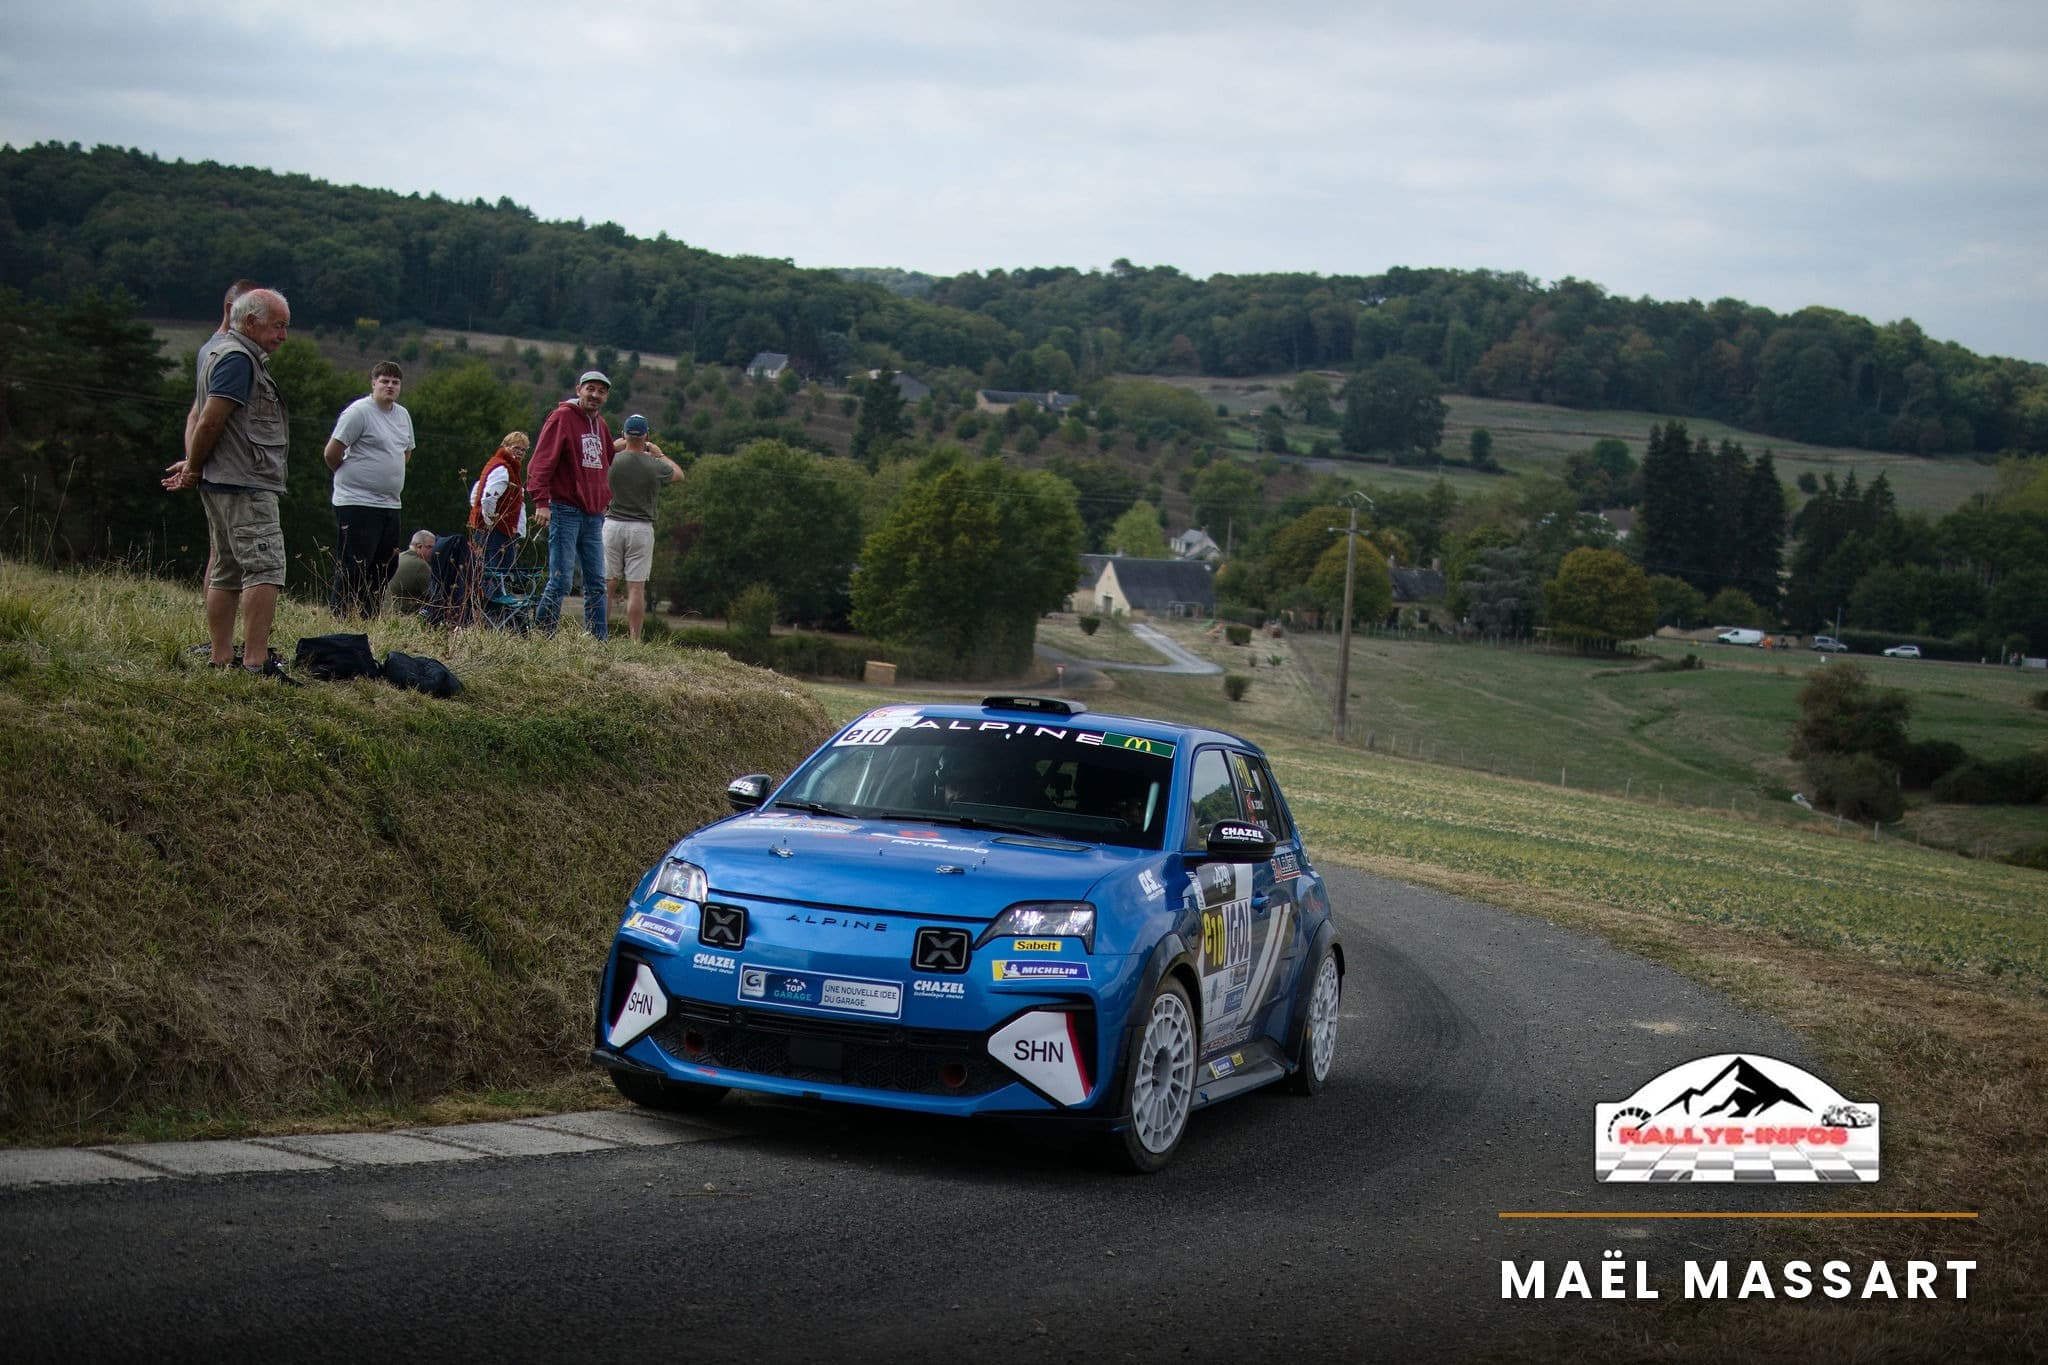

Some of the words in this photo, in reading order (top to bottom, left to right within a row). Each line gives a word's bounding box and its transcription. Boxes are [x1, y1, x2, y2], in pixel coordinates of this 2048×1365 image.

[842, 729, 893, 743] e10
[910, 720, 1102, 746] ALPINE
[1221, 827, 1264, 839] CHAZEL
[785, 914, 888, 932] ALPINE
[1016, 940, 1057, 951] Sabelt
[1203, 912, 1224, 968] e10
[693, 953, 736, 969] CHAZEL
[1021, 966, 1078, 975] MICHELIN
[785, 984, 803, 992] TOP
[824, 984, 840, 993] UNE
[840, 987, 879, 997] NOUVELLE
[913, 980, 965, 994] CHAZEL
[773, 990, 812, 1001] GARAGE
[824, 995, 836, 1004] DU
[628, 992, 653, 1016] SHN
[1014, 1039, 1064, 1063] SHN
